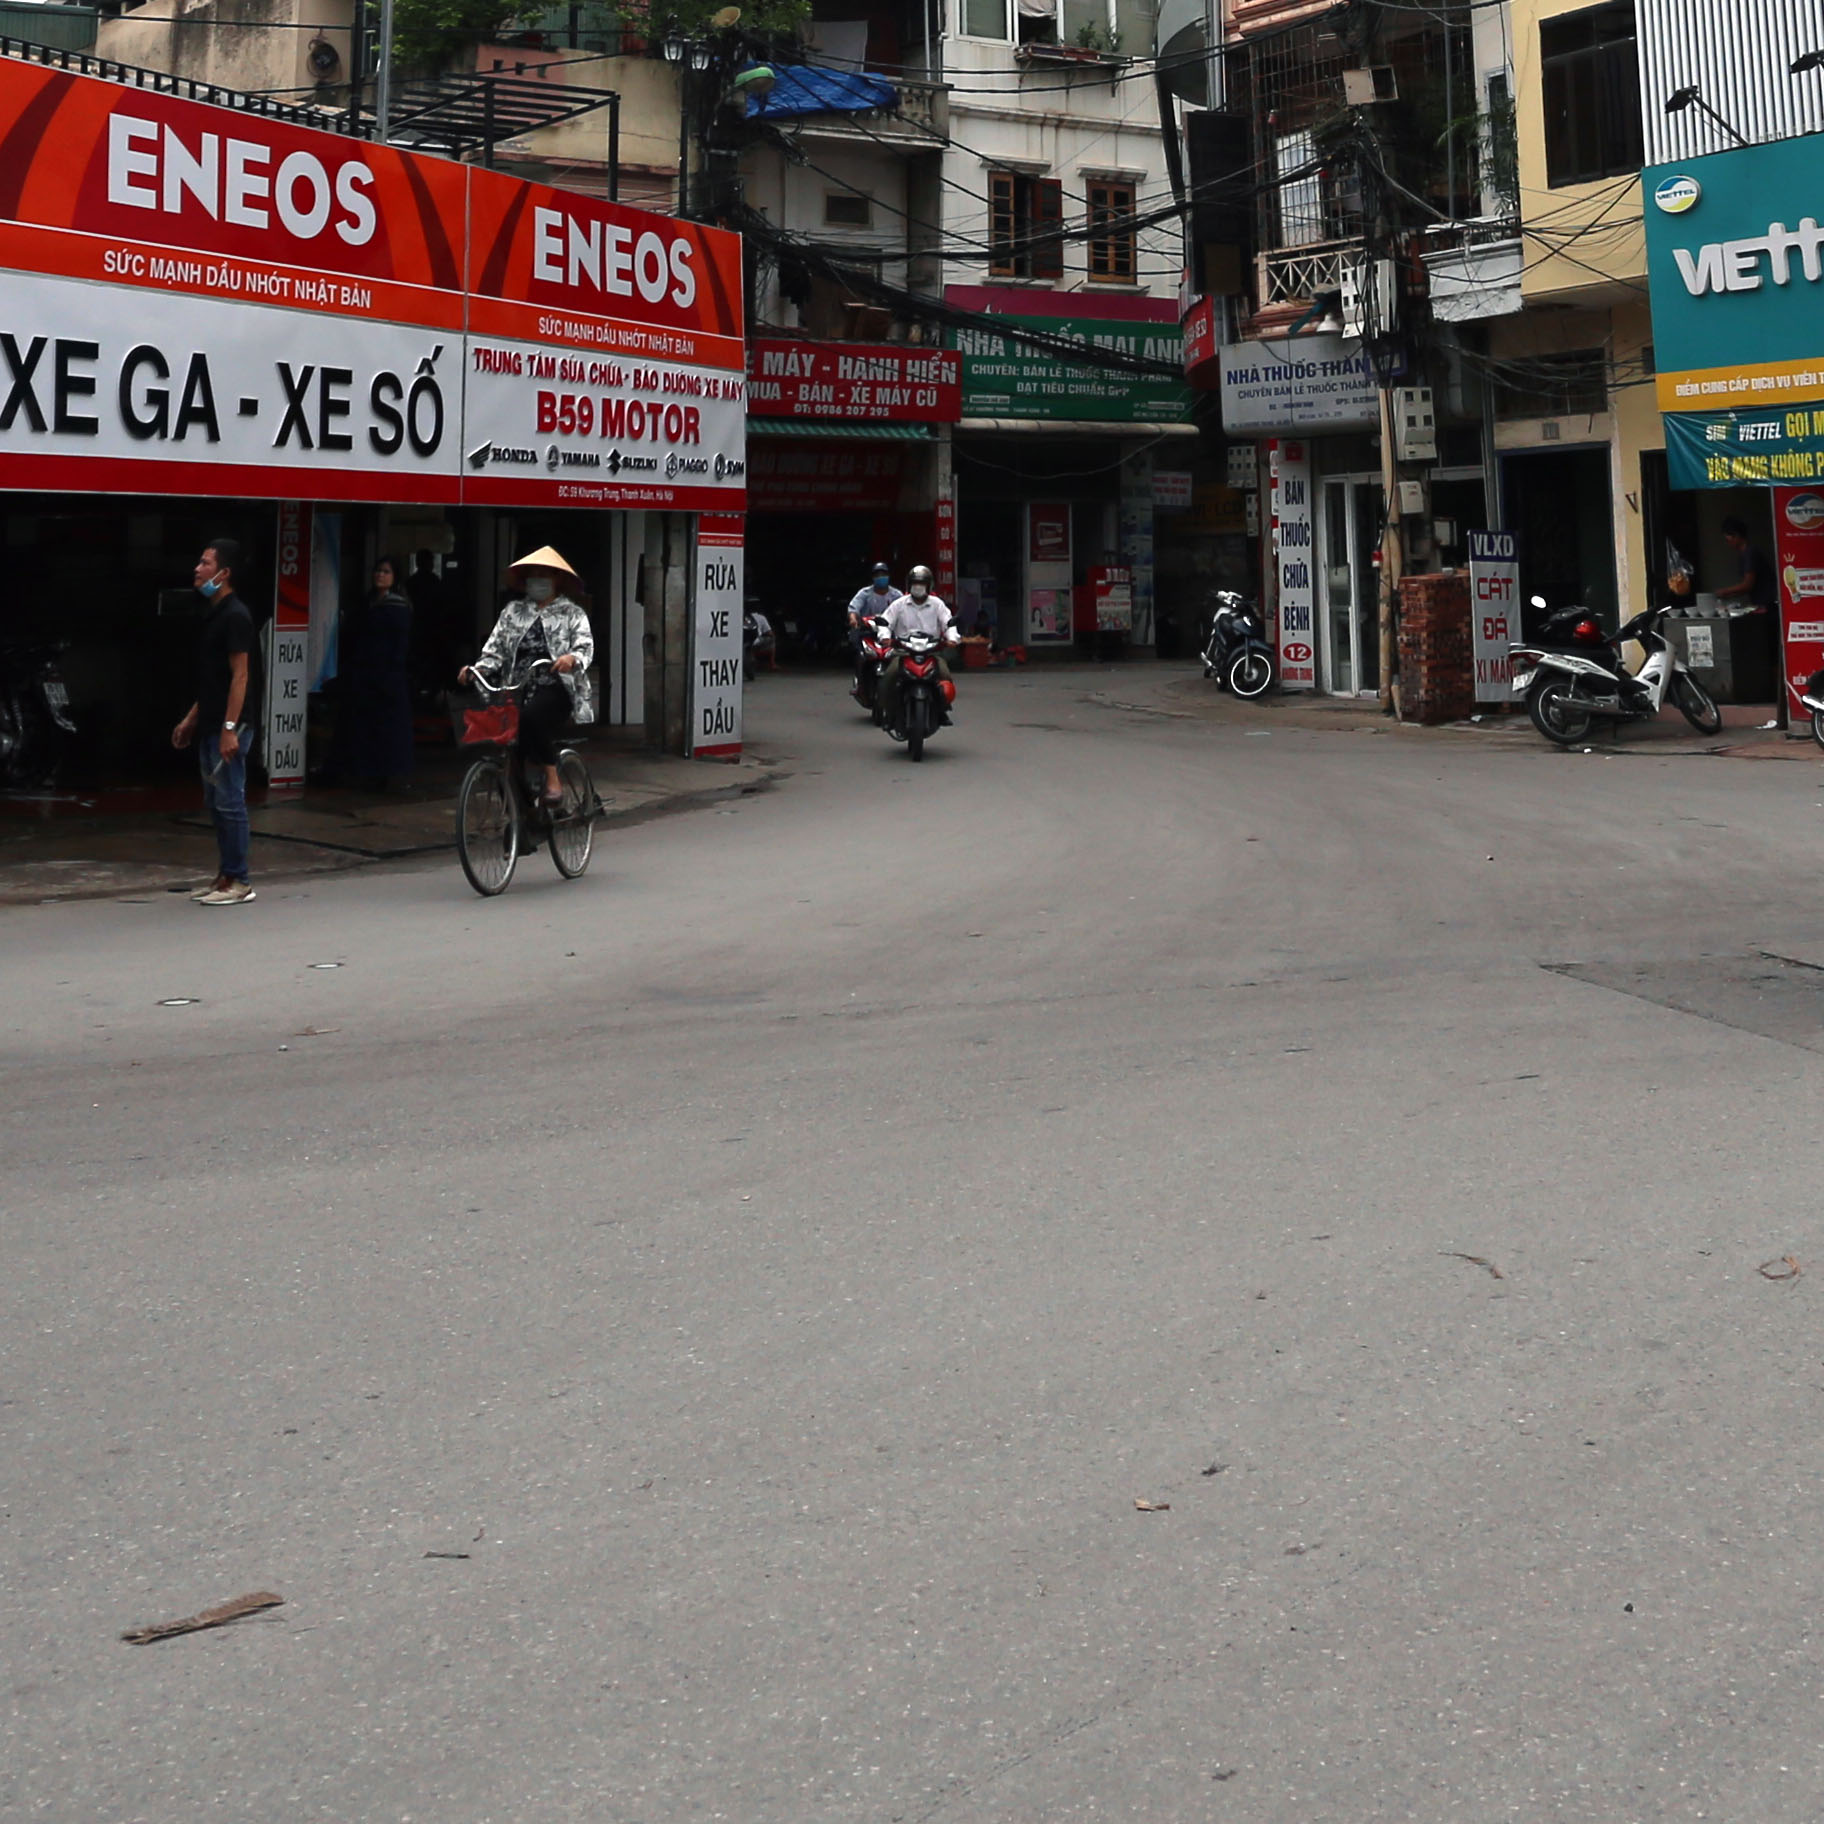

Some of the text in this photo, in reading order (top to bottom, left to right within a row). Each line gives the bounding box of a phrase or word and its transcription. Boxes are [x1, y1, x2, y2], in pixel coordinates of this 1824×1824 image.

[108, 112, 376, 246] ENEOS
[534, 205, 695, 309] ENEOS
[104, 248, 371, 309] SỨC MẠNH DẦU NHỚT NHẬT BẢN
[538, 315, 562, 337] SỨC
[564, 322, 594, 343] MẠNH
[618, 329, 647, 348] NHỚT
[648, 333, 673, 355] NHẬT
[763, 347, 815, 377] MÁY
[1144, 337, 1185, 365] ANH
[473, 348, 744, 402] TRUNG XE MÁY
[1023, 363, 1046, 377] BÁN
[1226, 358, 1316, 385] NHÀ THUỐC
[118, 343, 221, 442] GA
[273, 360, 353, 451] XE
[369, 344, 444, 457] SỐ
[799, 381, 834, 403] BÁN
[850, 386, 870, 404] XE
[876, 385, 911, 406] MÁY
[916, 387, 937, 407] CŨ
[536, 390, 701, 444] B59 MOTOR
[815, 404, 889, 417] 0986 207 295
[1739, 421, 1782, 442] VIETTEL
[1786, 412, 1810, 443] GỌI
[491, 448, 744, 476] HONDA YAMAHA SUZUKI PIAGGIO SYM
[1770, 448, 1814, 478] KHÔNG
[1285, 476, 1304, 505] BÁN
[1280, 513, 1310, 547] THUỐC
[1474, 534, 1514, 556] VLXD
[705, 556, 736, 591] RỬA
[1477, 572, 1513, 600] CÁT
[710, 611, 729, 637] XE
[1284, 601, 1309, 636] BỆNH
[1483, 612, 1508, 640] ĐÁ
[278, 639, 303, 663] RỬA
[1288, 646, 1307, 660] 12
[700, 659, 739, 688] THAY
[1476, 659, 1486, 683] XI
[283, 679, 298, 699] XE
[276, 714, 303, 733] THAY
[703, 697, 734, 736] DẦU
